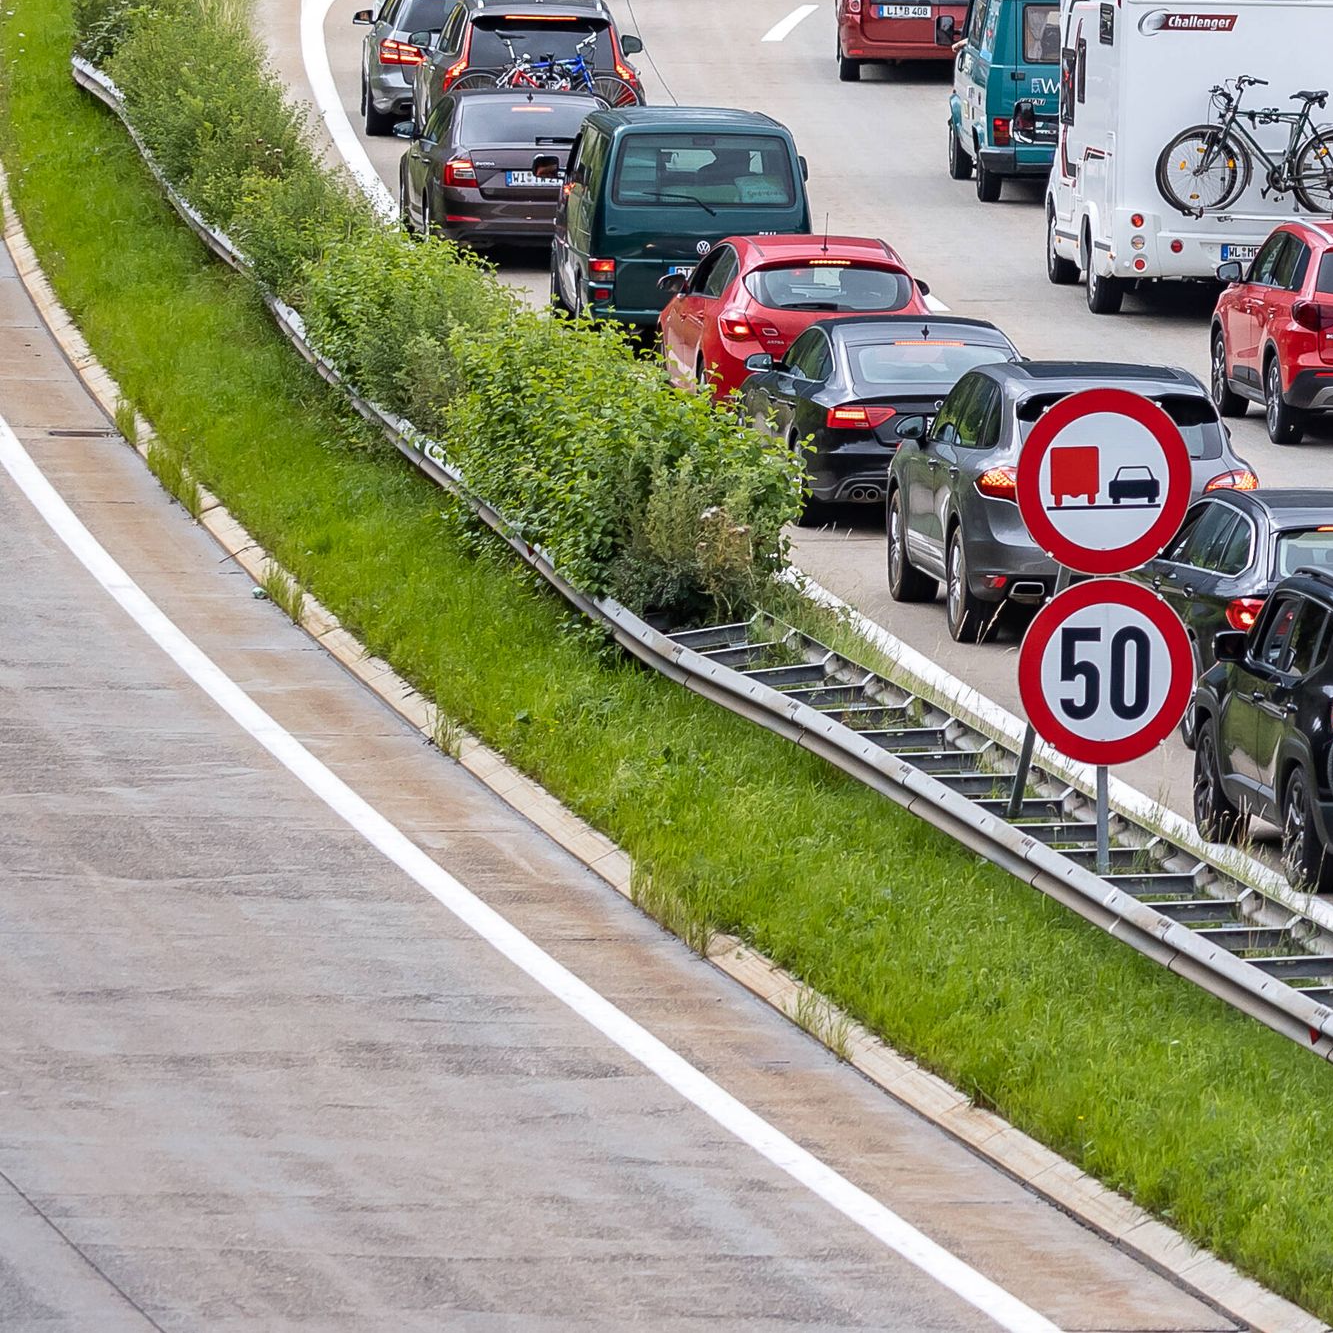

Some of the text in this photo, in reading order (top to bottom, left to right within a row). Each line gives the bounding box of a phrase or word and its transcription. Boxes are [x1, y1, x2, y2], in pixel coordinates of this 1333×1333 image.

[887, 6, 928, 17] LI B 408
[1168, 15, 1231, 30] Challenger
[513, 173, 525, 183] WI
[1229, 247, 1241, 257] WL
[1059, 625, 1152, 720] 50
